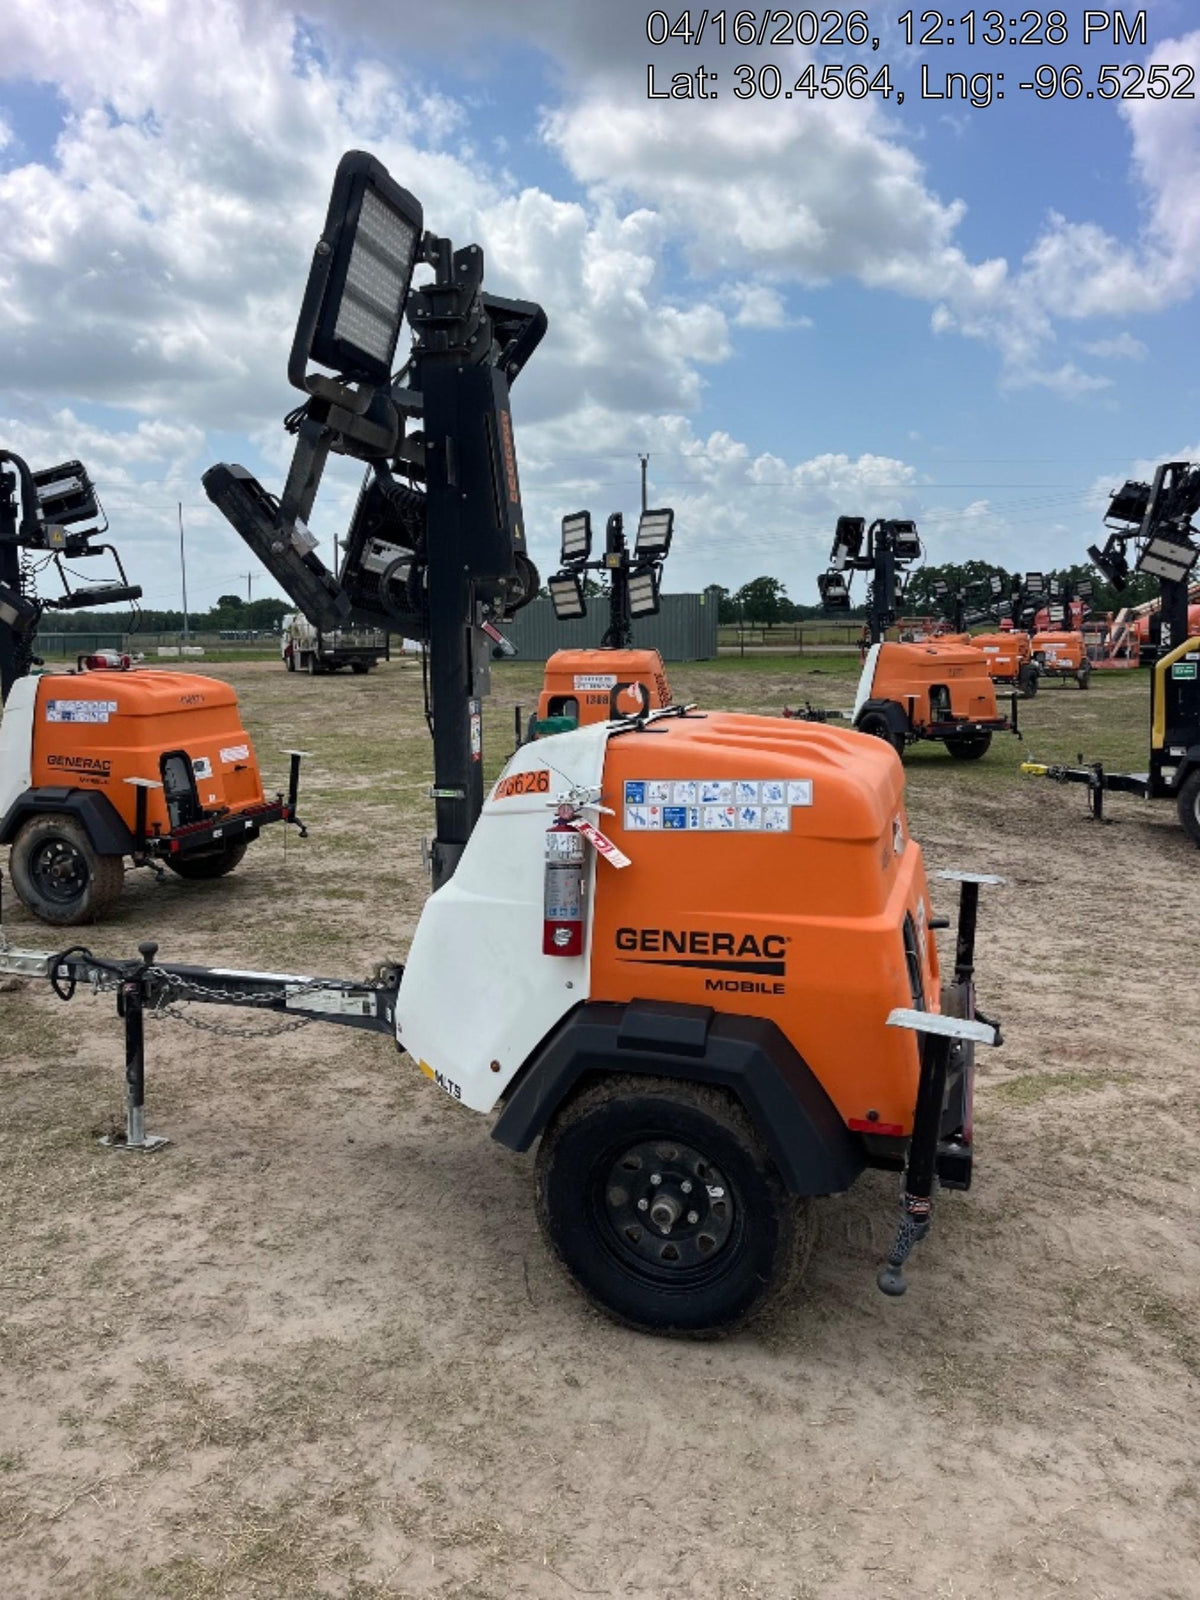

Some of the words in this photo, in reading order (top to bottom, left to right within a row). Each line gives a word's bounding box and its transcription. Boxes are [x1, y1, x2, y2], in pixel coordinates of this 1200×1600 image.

[47, 755, 111, 770] GENERAC
[614, 926, 787, 959] GENERAC
[704, 978, 787, 995] MOBILE
